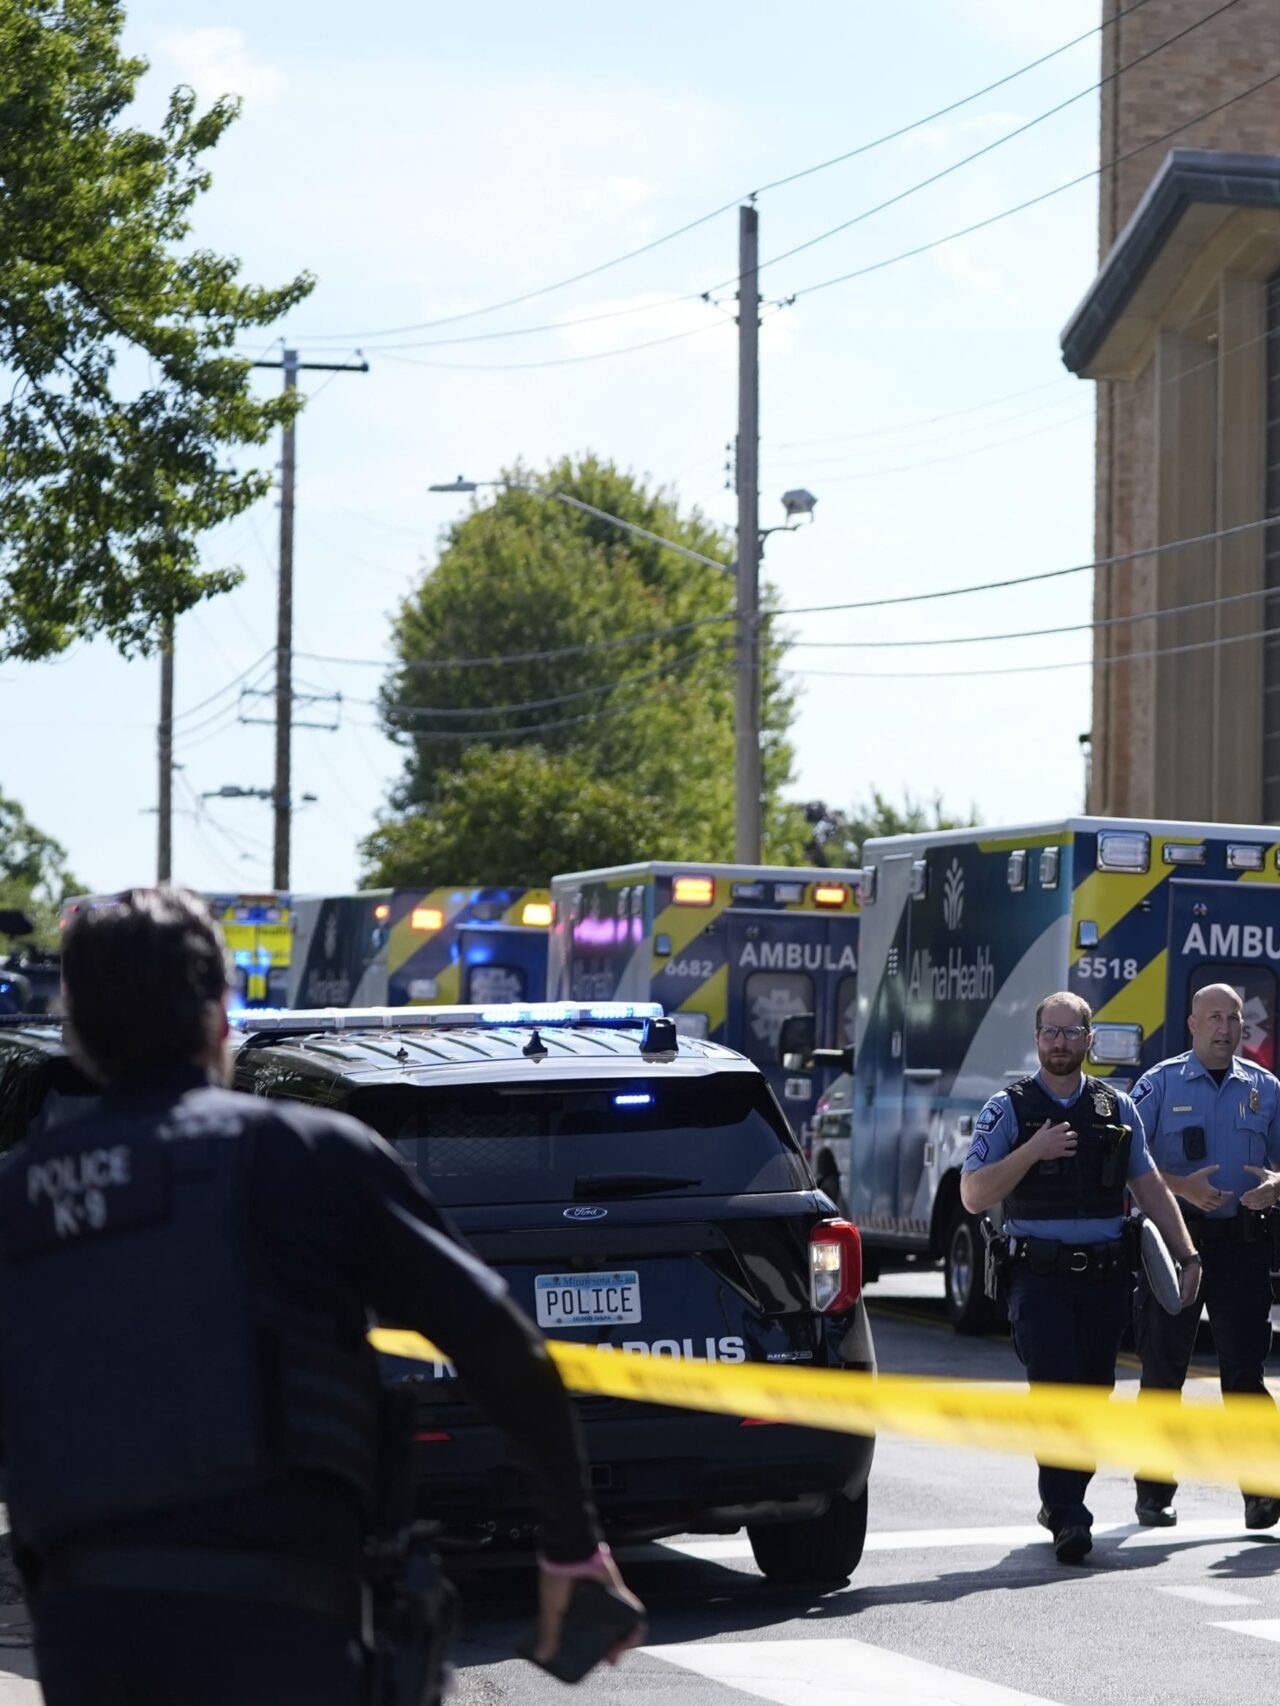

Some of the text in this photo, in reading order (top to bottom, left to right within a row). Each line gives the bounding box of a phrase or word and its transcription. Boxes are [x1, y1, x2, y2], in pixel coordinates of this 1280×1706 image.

[664, 960, 713, 978] 6682
[739, 941, 857, 971] AMBULA
[1077, 957, 1138, 980] 5518
[27, 1146, 131, 1204] POLICE
[562, 1276, 611, 1287] Minnesota
[546, 1287, 634, 1316] POLICE
